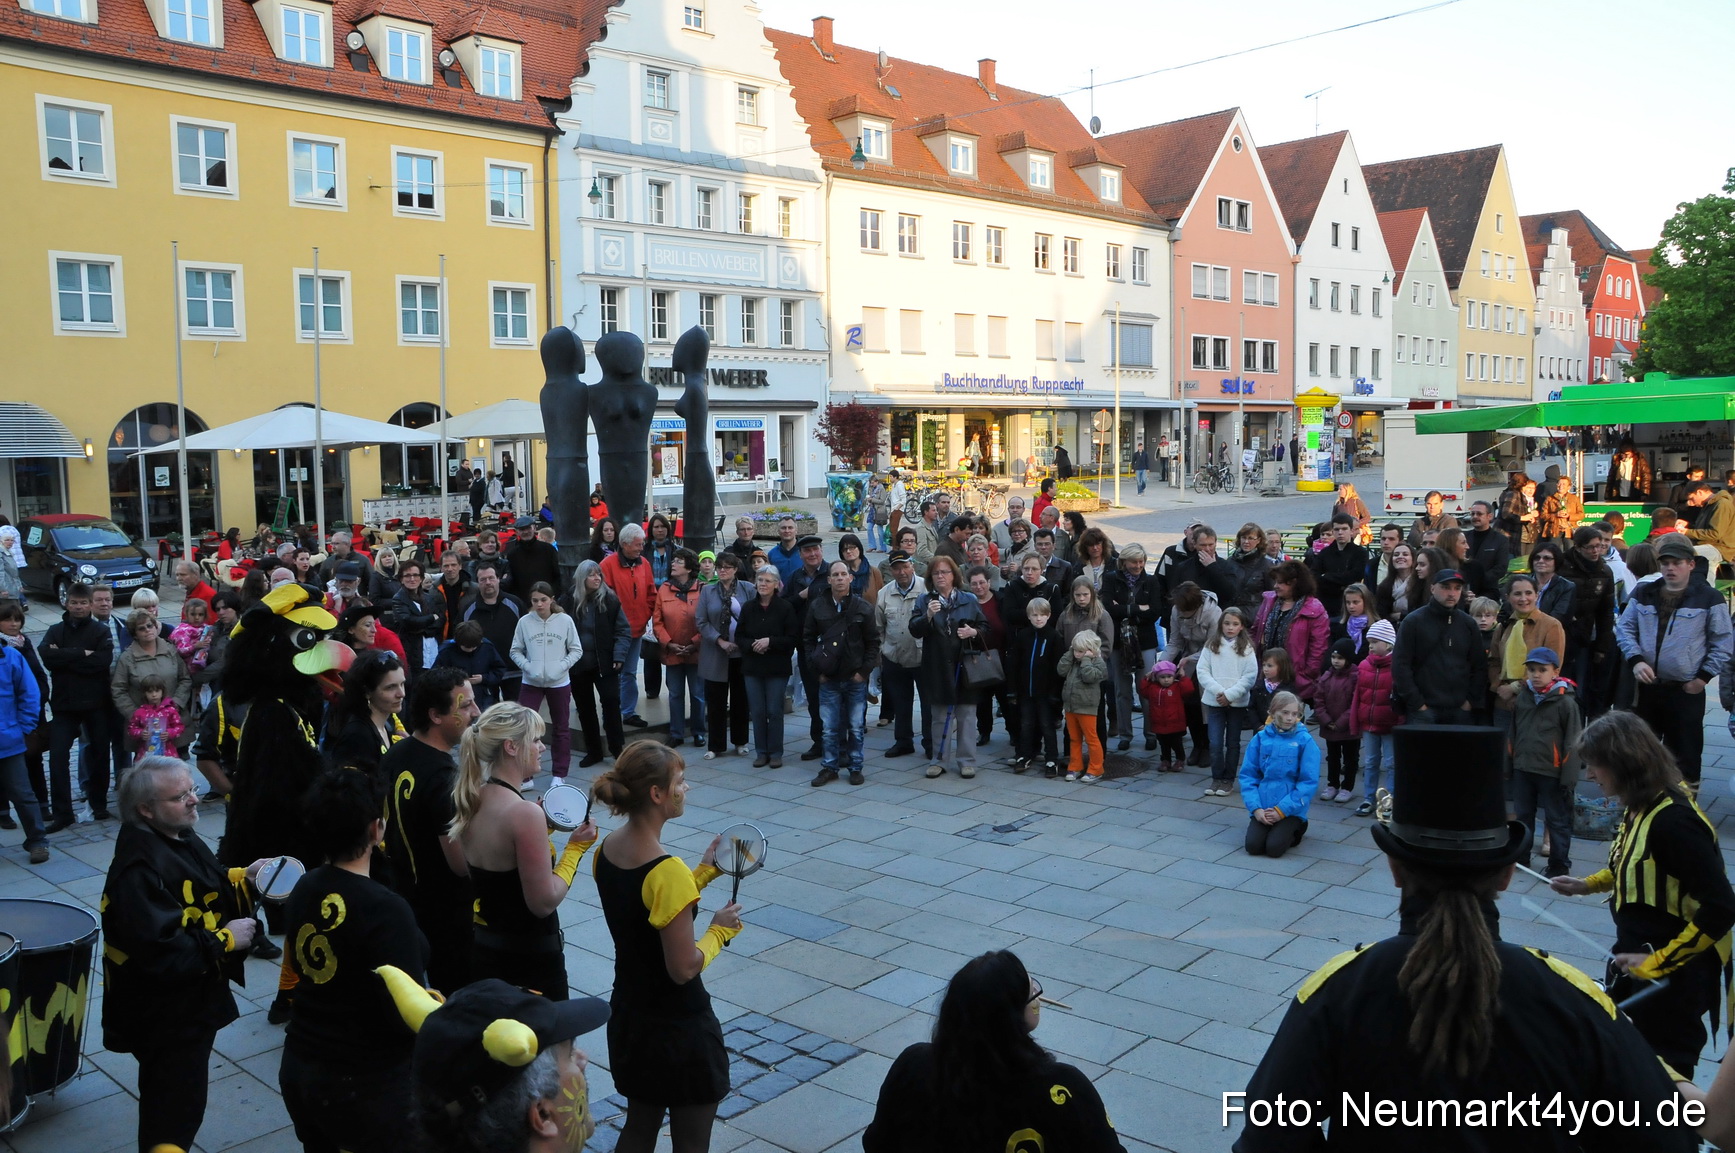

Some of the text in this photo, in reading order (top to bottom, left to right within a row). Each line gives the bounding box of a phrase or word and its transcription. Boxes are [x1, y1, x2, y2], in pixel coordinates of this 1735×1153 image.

[655, 248, 758, 273] BRILLEN WEBER
[647, 366, 770, 388] BRILL WEBER
[944, 373, 1084, 392] Buchhandlung Rupprecht
[718, 420, 761, 428] BRILLEN WEBER
[1341, 416, 1349, 424] 10
